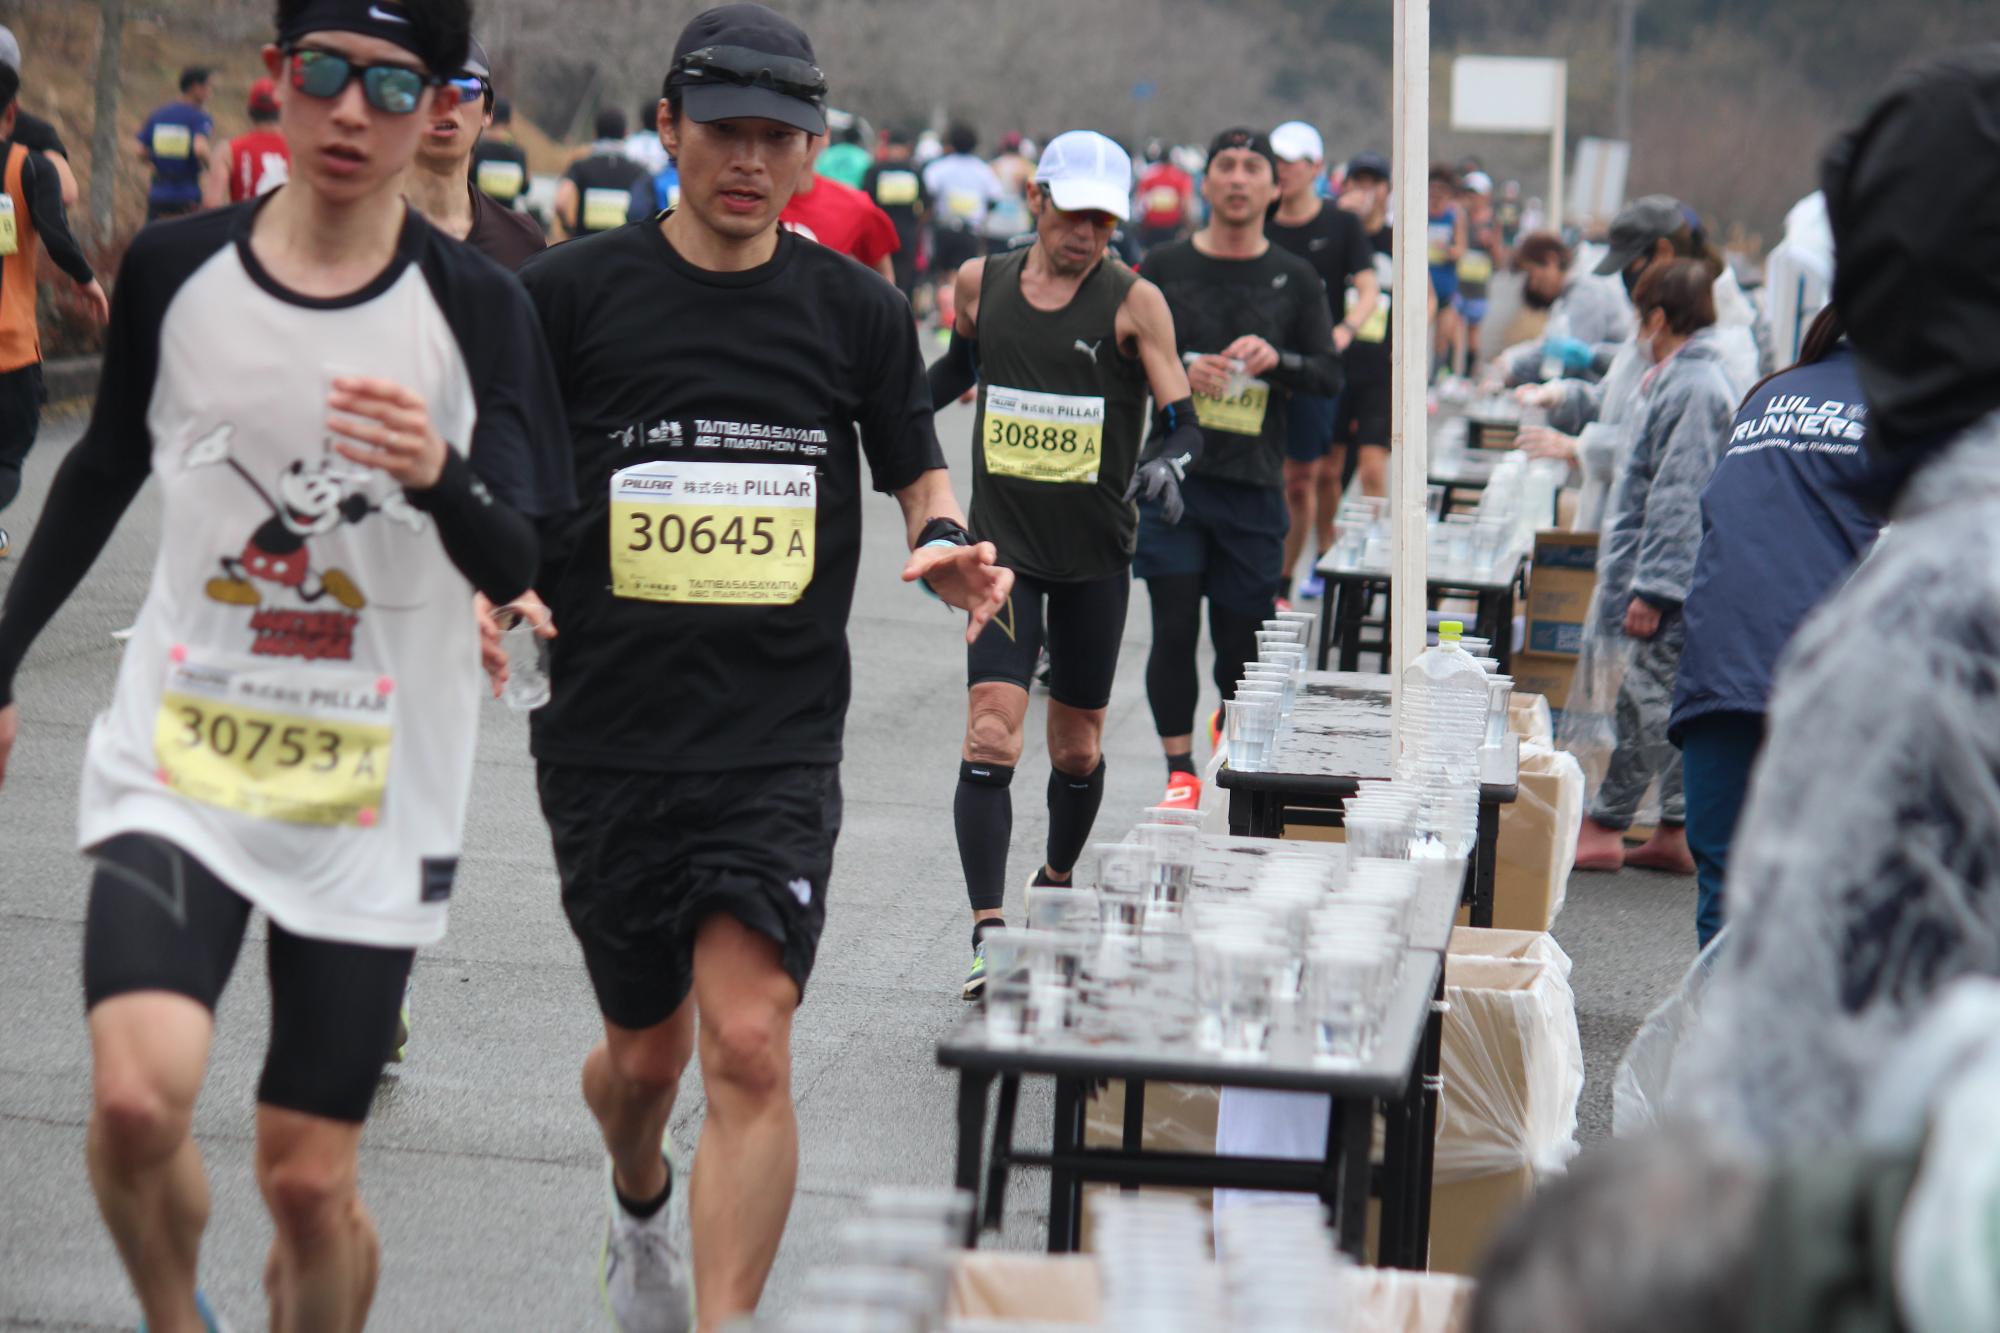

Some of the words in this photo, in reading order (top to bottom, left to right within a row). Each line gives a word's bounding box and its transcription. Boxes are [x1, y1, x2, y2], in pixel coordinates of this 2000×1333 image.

[1057, 405, 1100, 418] PILLAR
[1765, 394, 1845, 417] WILD
[694, 419, 828, 443] TAMBASASAYAMA
[989, 419, 1077, 454] 30888
[1083, 437, 1095, 455] A
[1729, 412, 1867, 445] RUNNERS
[694, 436, 720, 447] ABC
[723, 437, 796, 453] MARATHON
[620, 478, 673, 491] PILLAR
[682, 480, 740, 495] 株式会社
[743, 480, 811, 497] PILLAR
[628, 512, 775, 556] 30645
[786, 528, 807, 558] A
[308, 688, 388, 713] PILLAR
[175, 706, 344, 774] 30753
[353, 744, 376, 782] A
